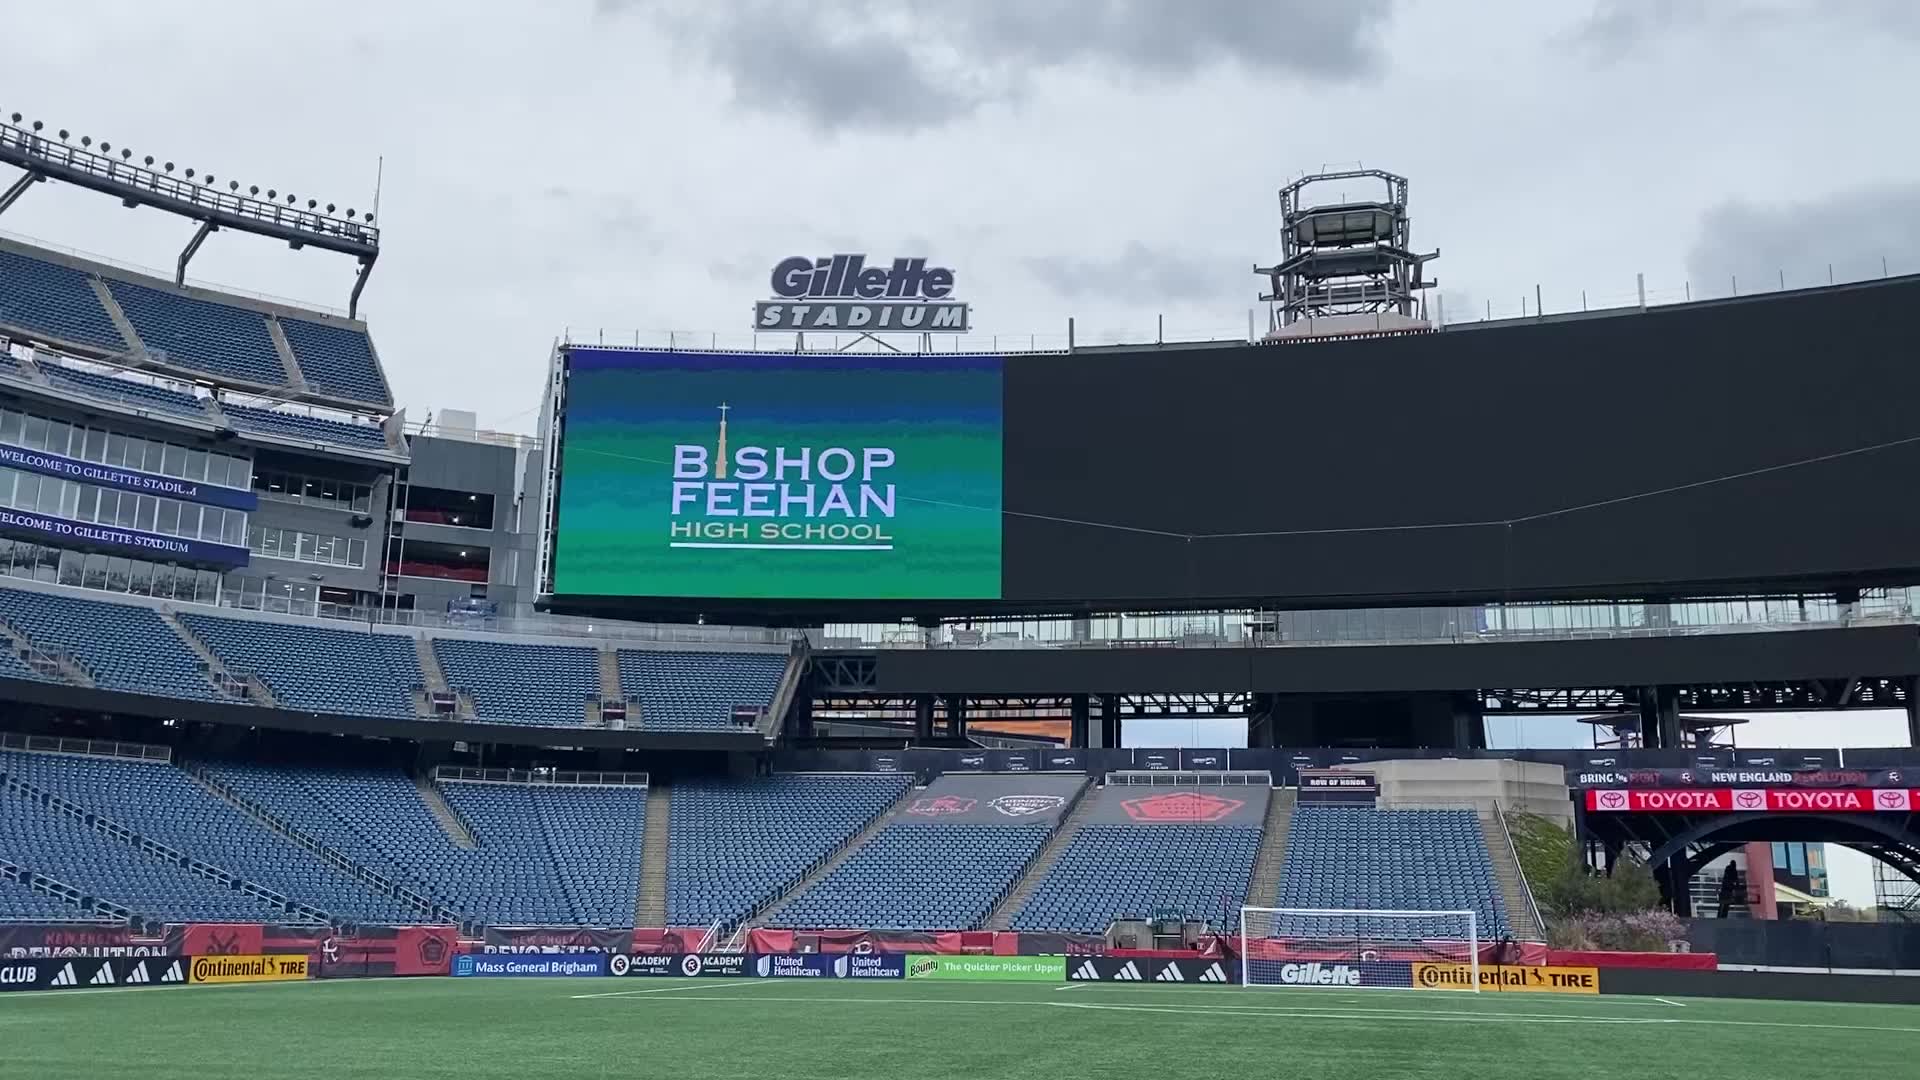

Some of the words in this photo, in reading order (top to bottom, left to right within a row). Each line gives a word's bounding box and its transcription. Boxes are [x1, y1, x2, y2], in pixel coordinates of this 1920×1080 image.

[771, 254, 954, 299] Gillette
[760, 305, 964, 328] STADIUM
[673, 421, 896, 481] BISHOP
[0, 449, 62, 471] WELCOME
[65, 463, 81, 475] TO
[83, 467, 141, 486] GILLETTE
[671, 481, 896, 518] FEEHAN
[0, 512, 53, 531] ELCOME
[55, 523, 72, 534] TO
[74, 526, 133, 544] GILLETTE
[134, 536, 189, 553] STADIUM
[671, 521, 749, 538] HIGH
[760, 522, 893, 540] SCHOOL
[1580, 773, 1614, 784] BRING
[1711, 772, 1737, 782] NEW
[1739, 772, 1792, 783] ENGLAND
[1636, 792, 1720, 808] TOYOTA
[1773, 792, 1862, 808] TOYOTA
[476, 962, 504, 973] Mass
[506, 962, 549, 973] General
[551, 962, 597, 975] Brigham
[630, 956, 672, 966] ACADEMY
[702, 956, 744, 966] ACADEMY
[774, 956, 803, 966] United
[851, 956, 881, 967] United
[910, 960, 939, 977] Bounty
[944, 962, 962, 972] The
[964, 962, 1000, 973] Quicker
[1003, 963, 1032, 972] Picker
[1034, 964, 1064, 974] Upper
[1, 966, 37, 983] CLUB
[194, 958, 266, 981] Continental
[279, 961, 305, 975] TIRE
[774, 966, 821, 977] Healthcare
[851, 966, 900, 977] Healthcare
[1280, 963, 1361, 985] Gillette
[1548, 973, 1593, 988] TIRE
